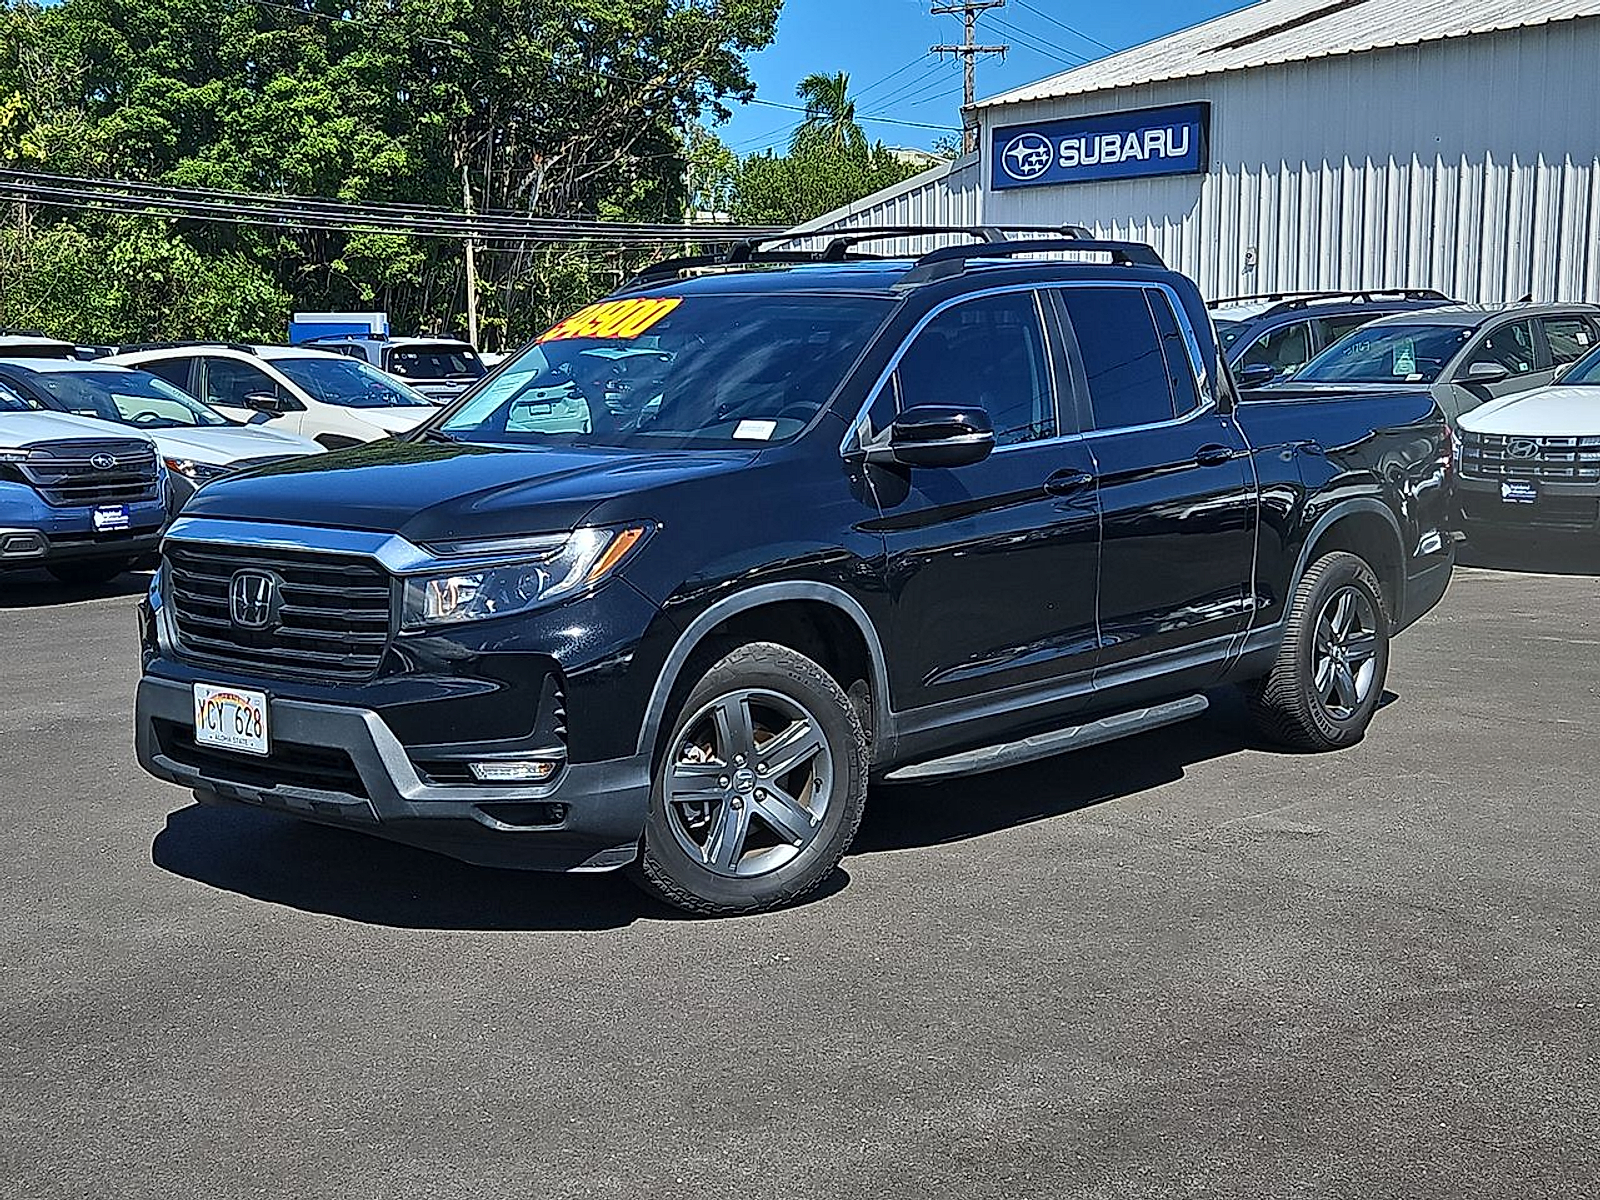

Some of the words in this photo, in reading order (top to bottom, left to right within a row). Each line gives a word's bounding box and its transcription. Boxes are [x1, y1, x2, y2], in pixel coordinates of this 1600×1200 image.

[1059, 126, 1189, 168] SUBARU
[198, 698, 224, 732] YCY
[235, 706, 262, 739] 628
